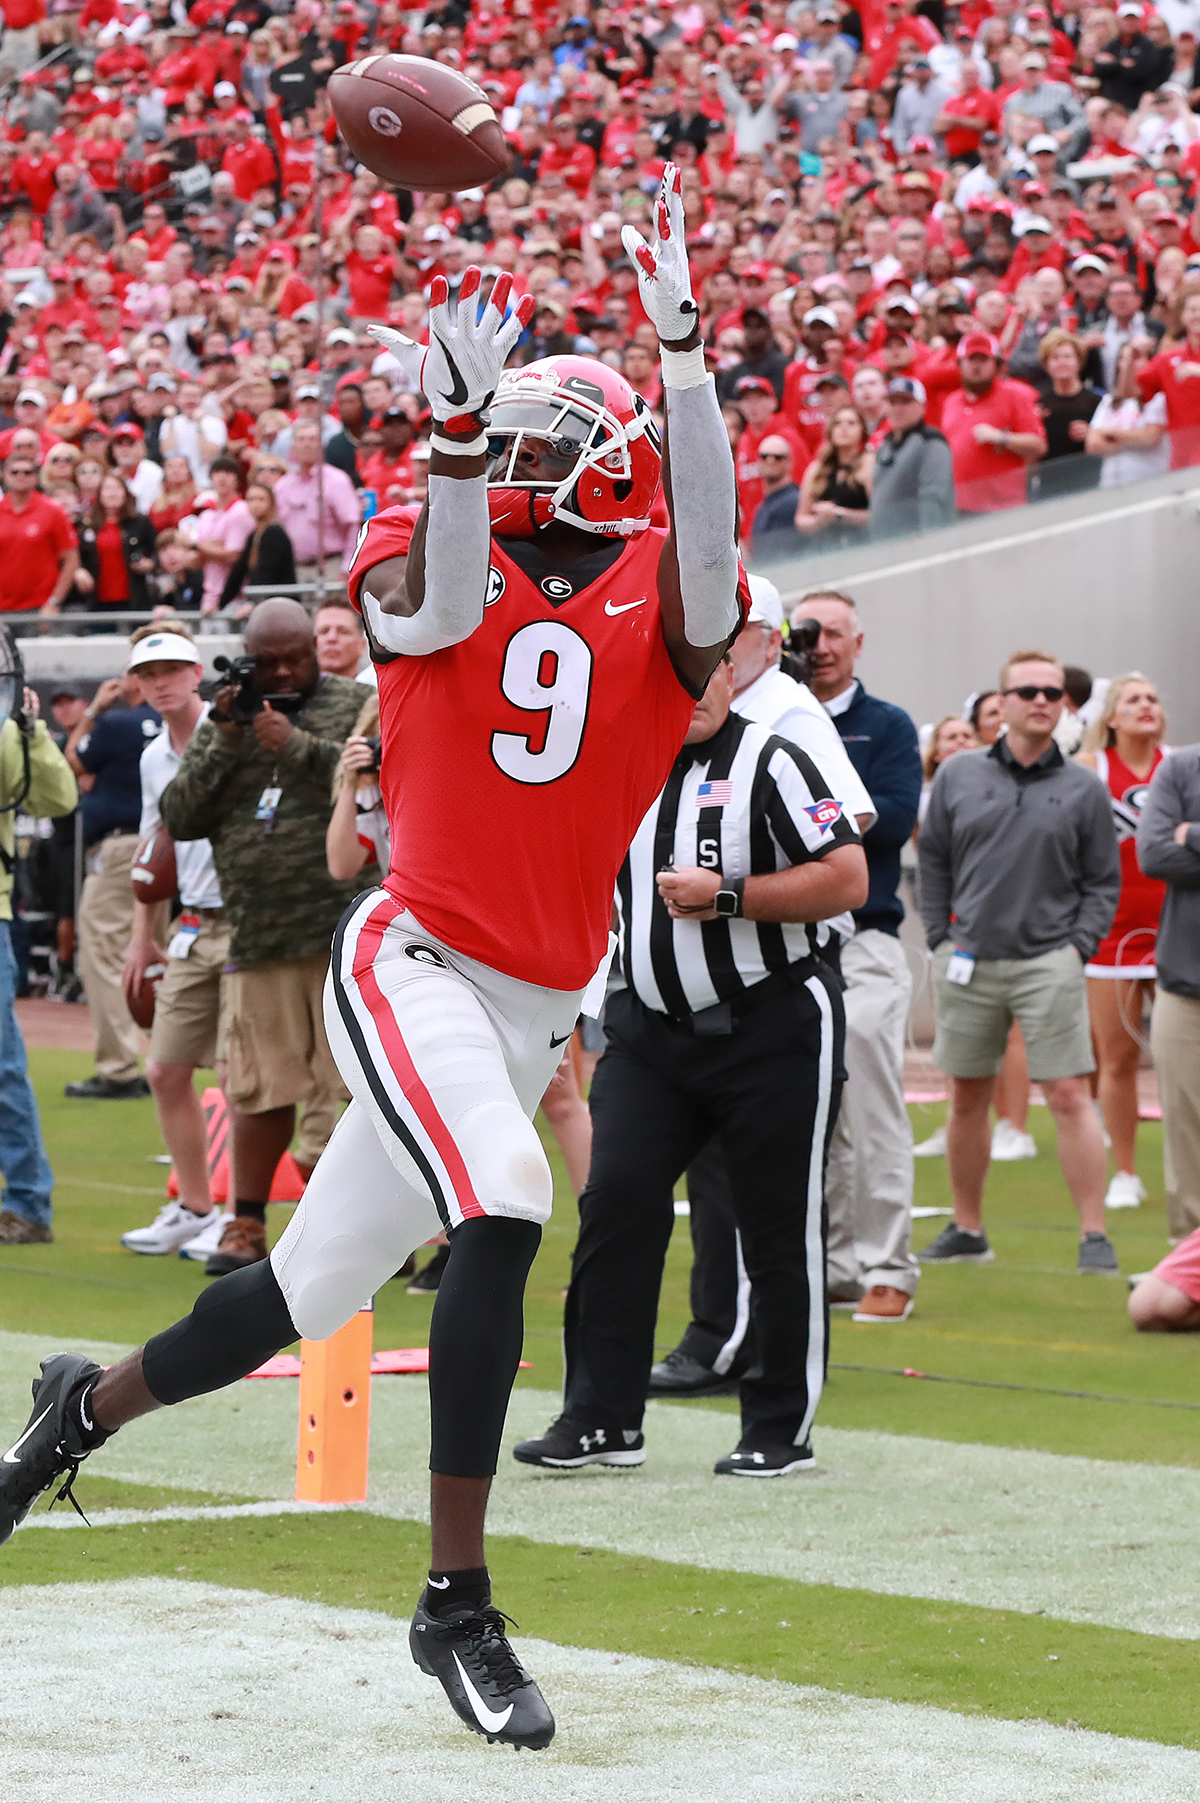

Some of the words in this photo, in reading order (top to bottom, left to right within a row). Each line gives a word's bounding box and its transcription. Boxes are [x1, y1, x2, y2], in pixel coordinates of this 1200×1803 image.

[540, 575, 573, 599] G
[489, 618, 594, 786] 9
[699, 838, 720, 868] S
